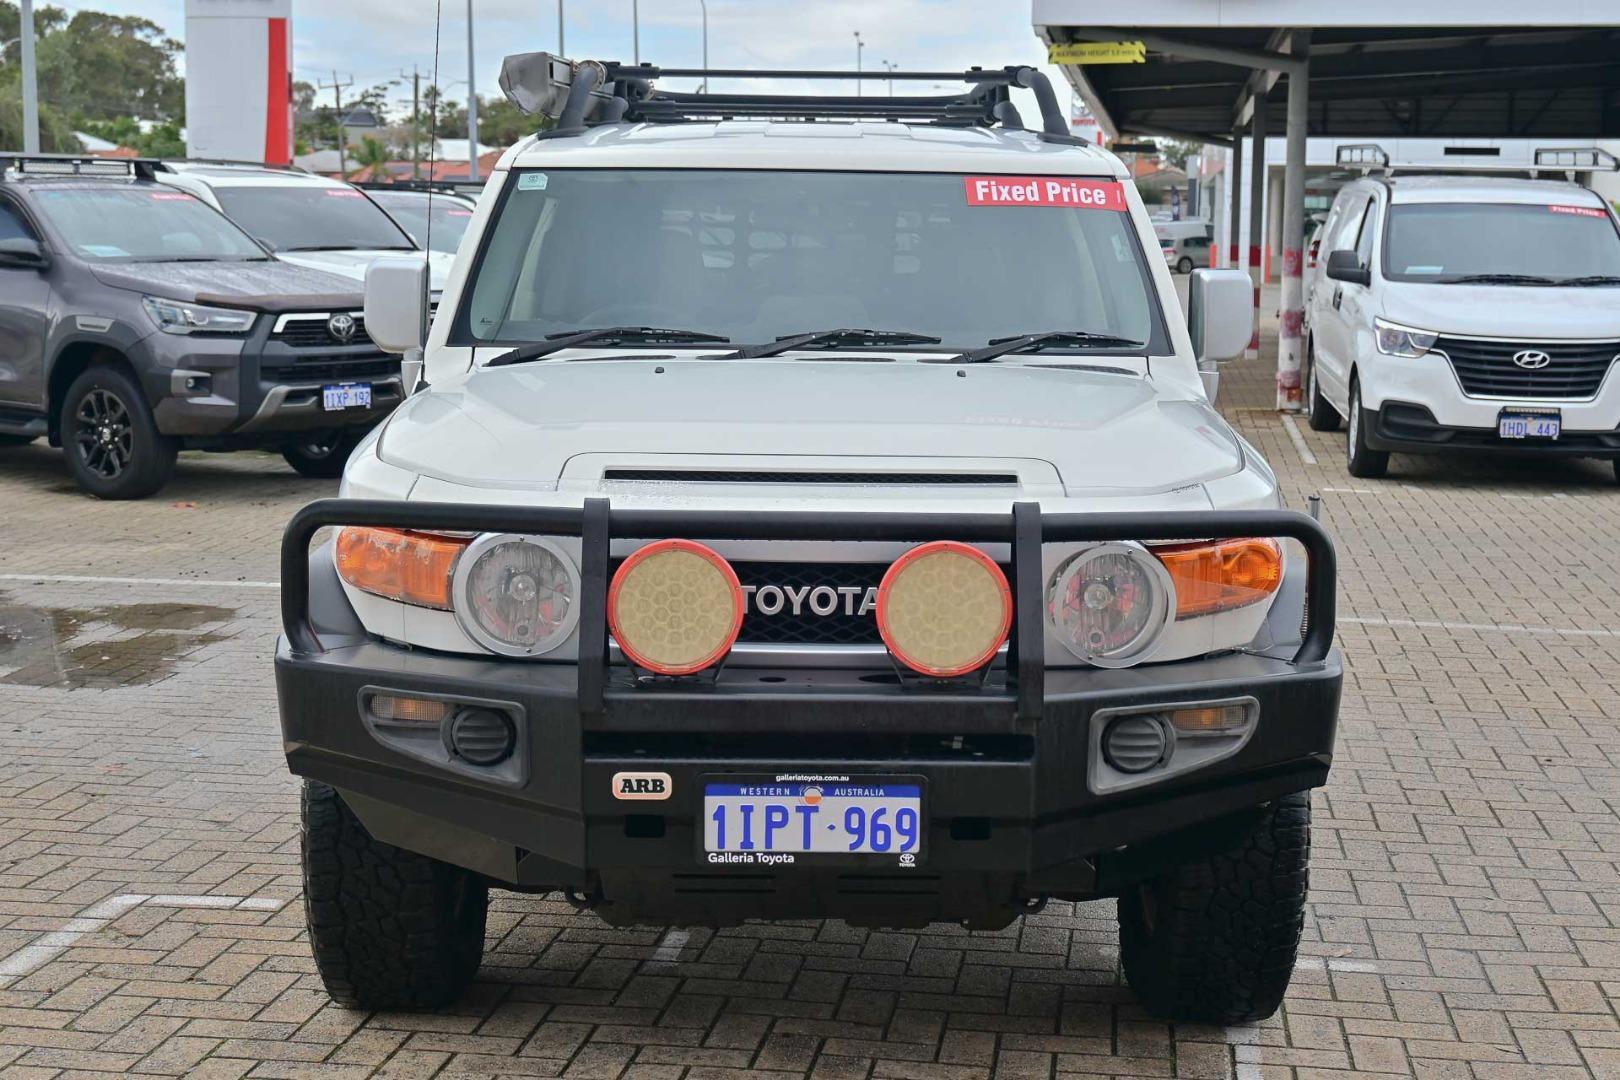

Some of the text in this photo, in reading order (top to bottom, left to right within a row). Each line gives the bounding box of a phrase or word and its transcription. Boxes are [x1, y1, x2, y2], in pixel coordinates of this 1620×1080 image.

[975, 180, 1106, 205] Fixed Price
[739, 585, 878, 616] TOYOTA
[620, 778, 666, 794] ARB
[775, 774, 850, 783] galleriatoyota.com.au
[740, 787, 885, 797] WESTERN AUSTRALIA
[707, 852, 795, 866] Galleria Toyota
